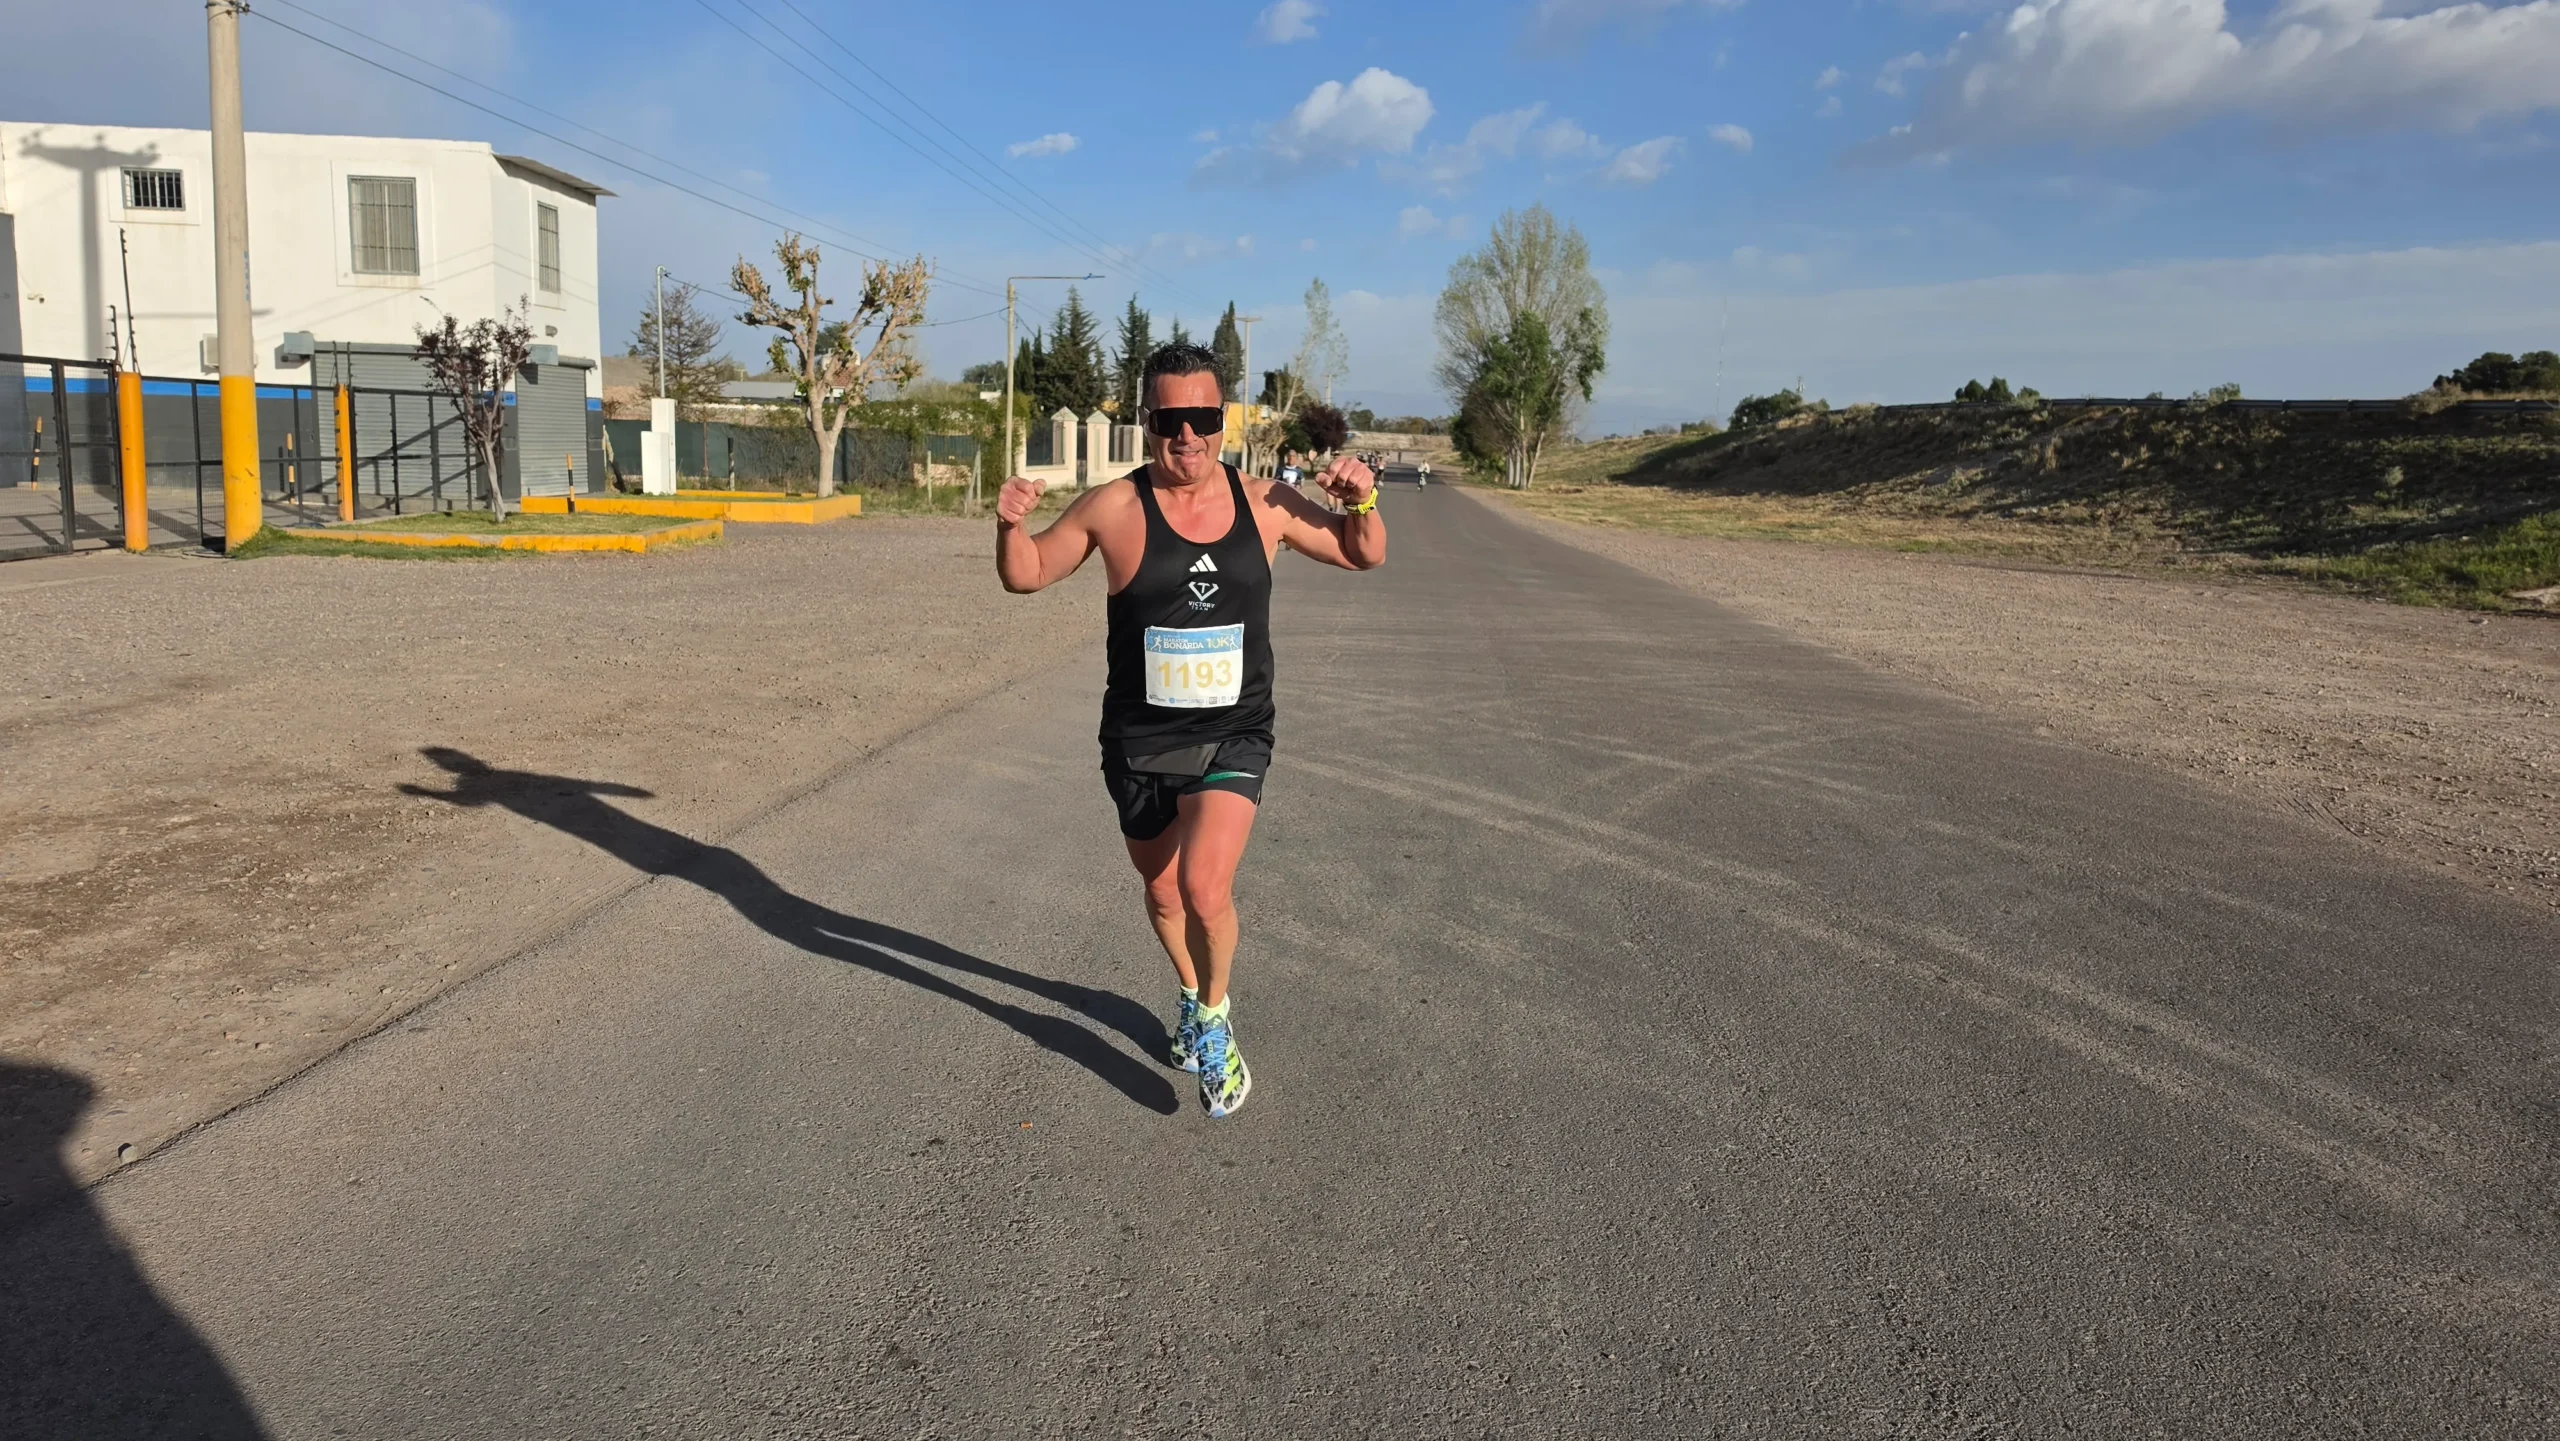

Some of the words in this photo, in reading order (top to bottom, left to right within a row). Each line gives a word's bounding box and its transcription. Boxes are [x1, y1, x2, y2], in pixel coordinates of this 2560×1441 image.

[1188, 600, 1215, 608] VICTORY
[1206, 636, 1230, 649] 10K
[1158, 660, 1232, 689] 1193
